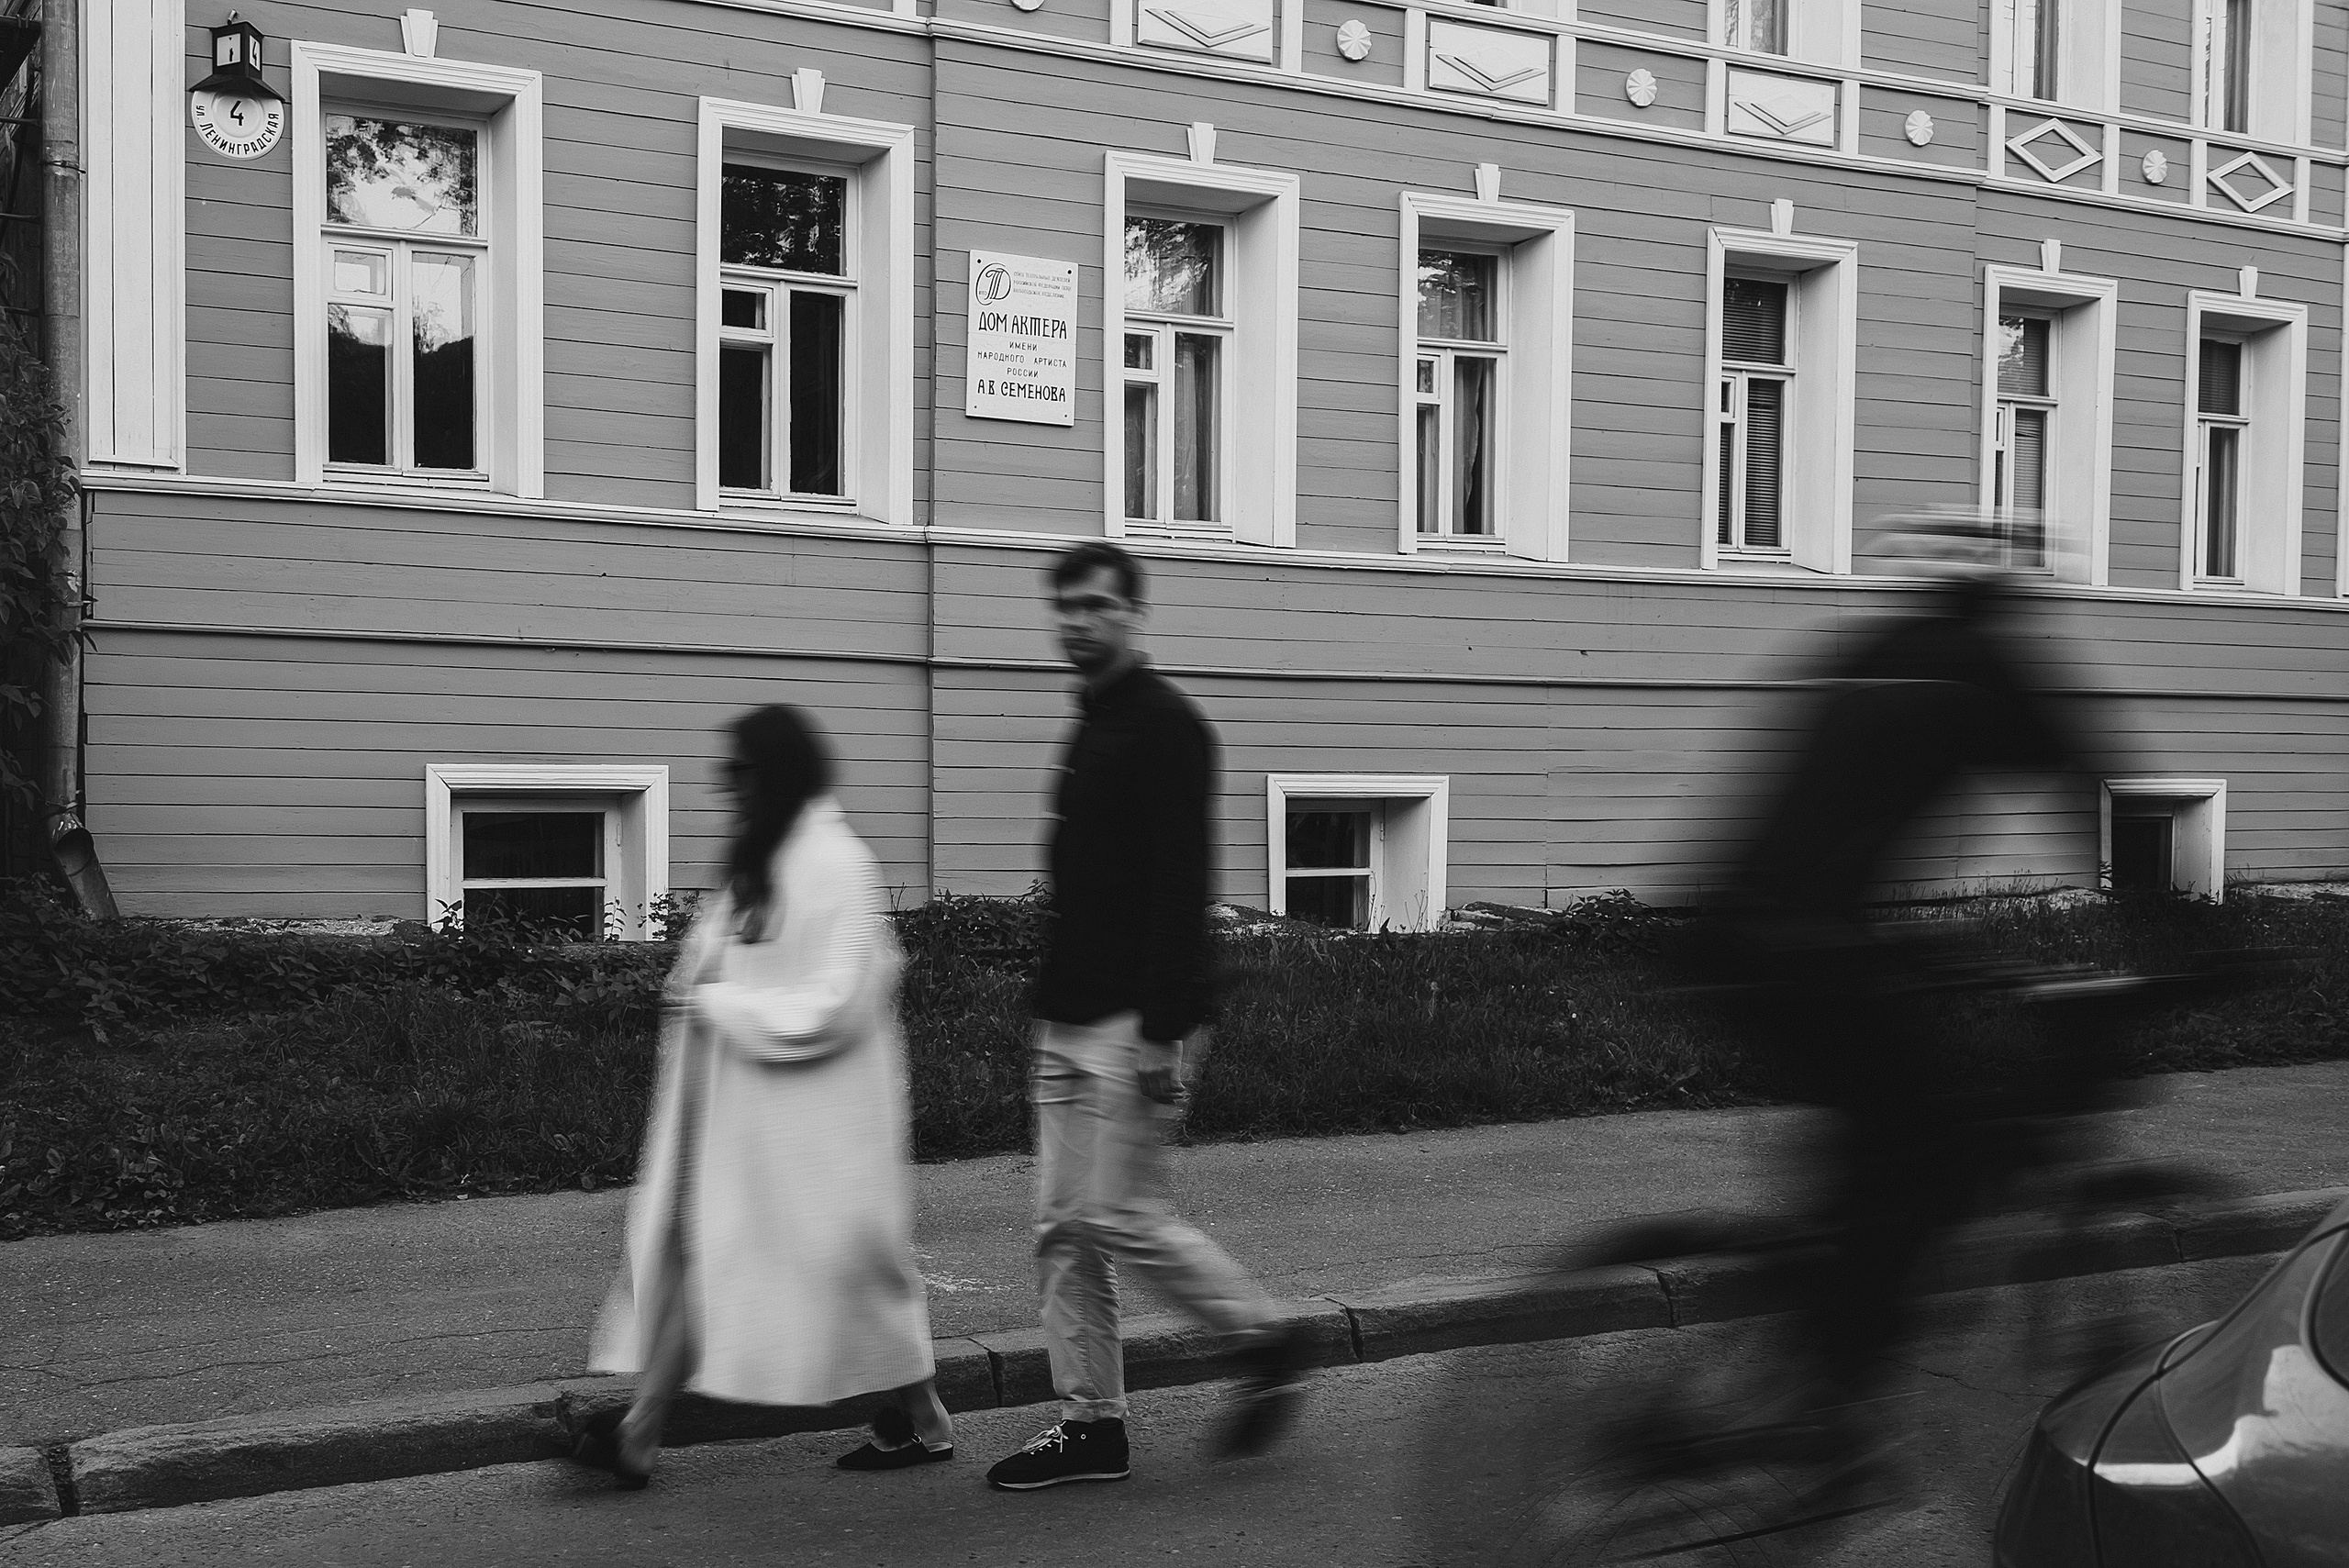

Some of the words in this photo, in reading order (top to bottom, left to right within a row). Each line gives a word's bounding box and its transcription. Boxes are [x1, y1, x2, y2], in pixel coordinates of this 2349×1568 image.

[230, 100, 244, 126] 4
[199, 113, 280, 155] ЛЕНИНГРАДСКАЯ
[978, 311, 1008, 333] ДОМ
[1011, 315, 1067, 339] АКТЕРА
[1009, 340, 1038, 351] ИМЕНИ
[977, 350, 1025, 363] НАРОДНОГО
[1033, 357, 1067, 368] АРТИСТА
[1007, 367, 1039, 378] РОССИИ
[1000, 381, 1066, 403] СЕМЕНОВА
